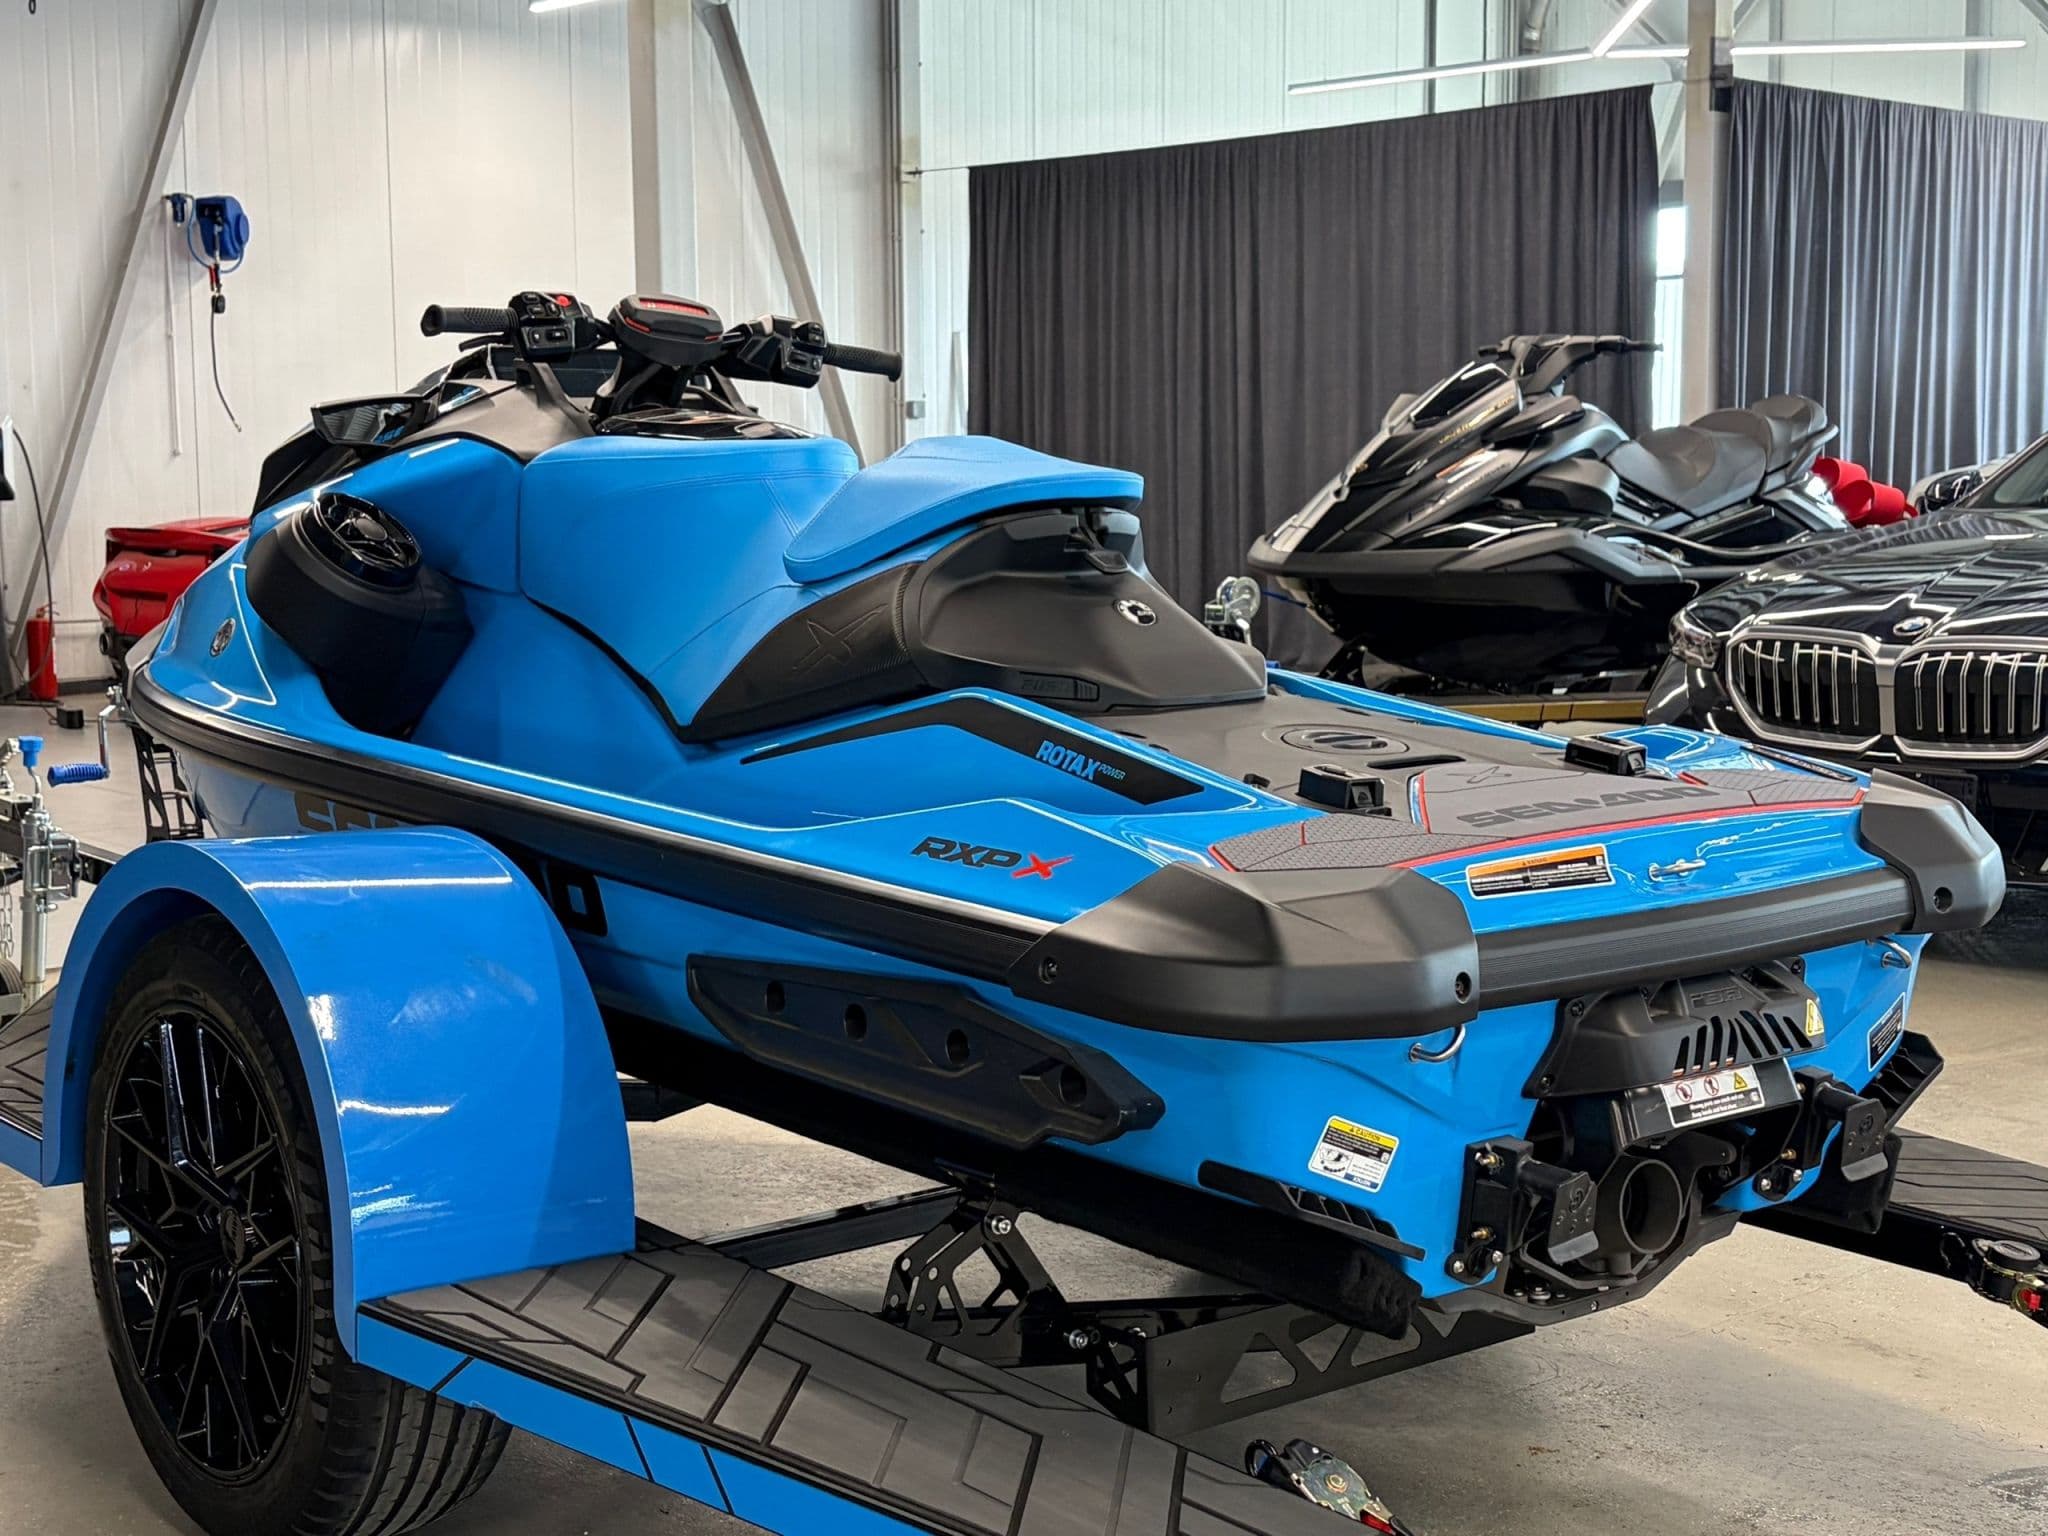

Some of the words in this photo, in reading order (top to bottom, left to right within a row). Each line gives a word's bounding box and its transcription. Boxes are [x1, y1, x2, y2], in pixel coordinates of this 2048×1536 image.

[1036, 740, 1101, 781] ROTAX
[1098, 763, 1126, 780] POWER
[911, 836, 1023, 868] RXP
[1355, 1127, 1381, 1142] CAUTION
